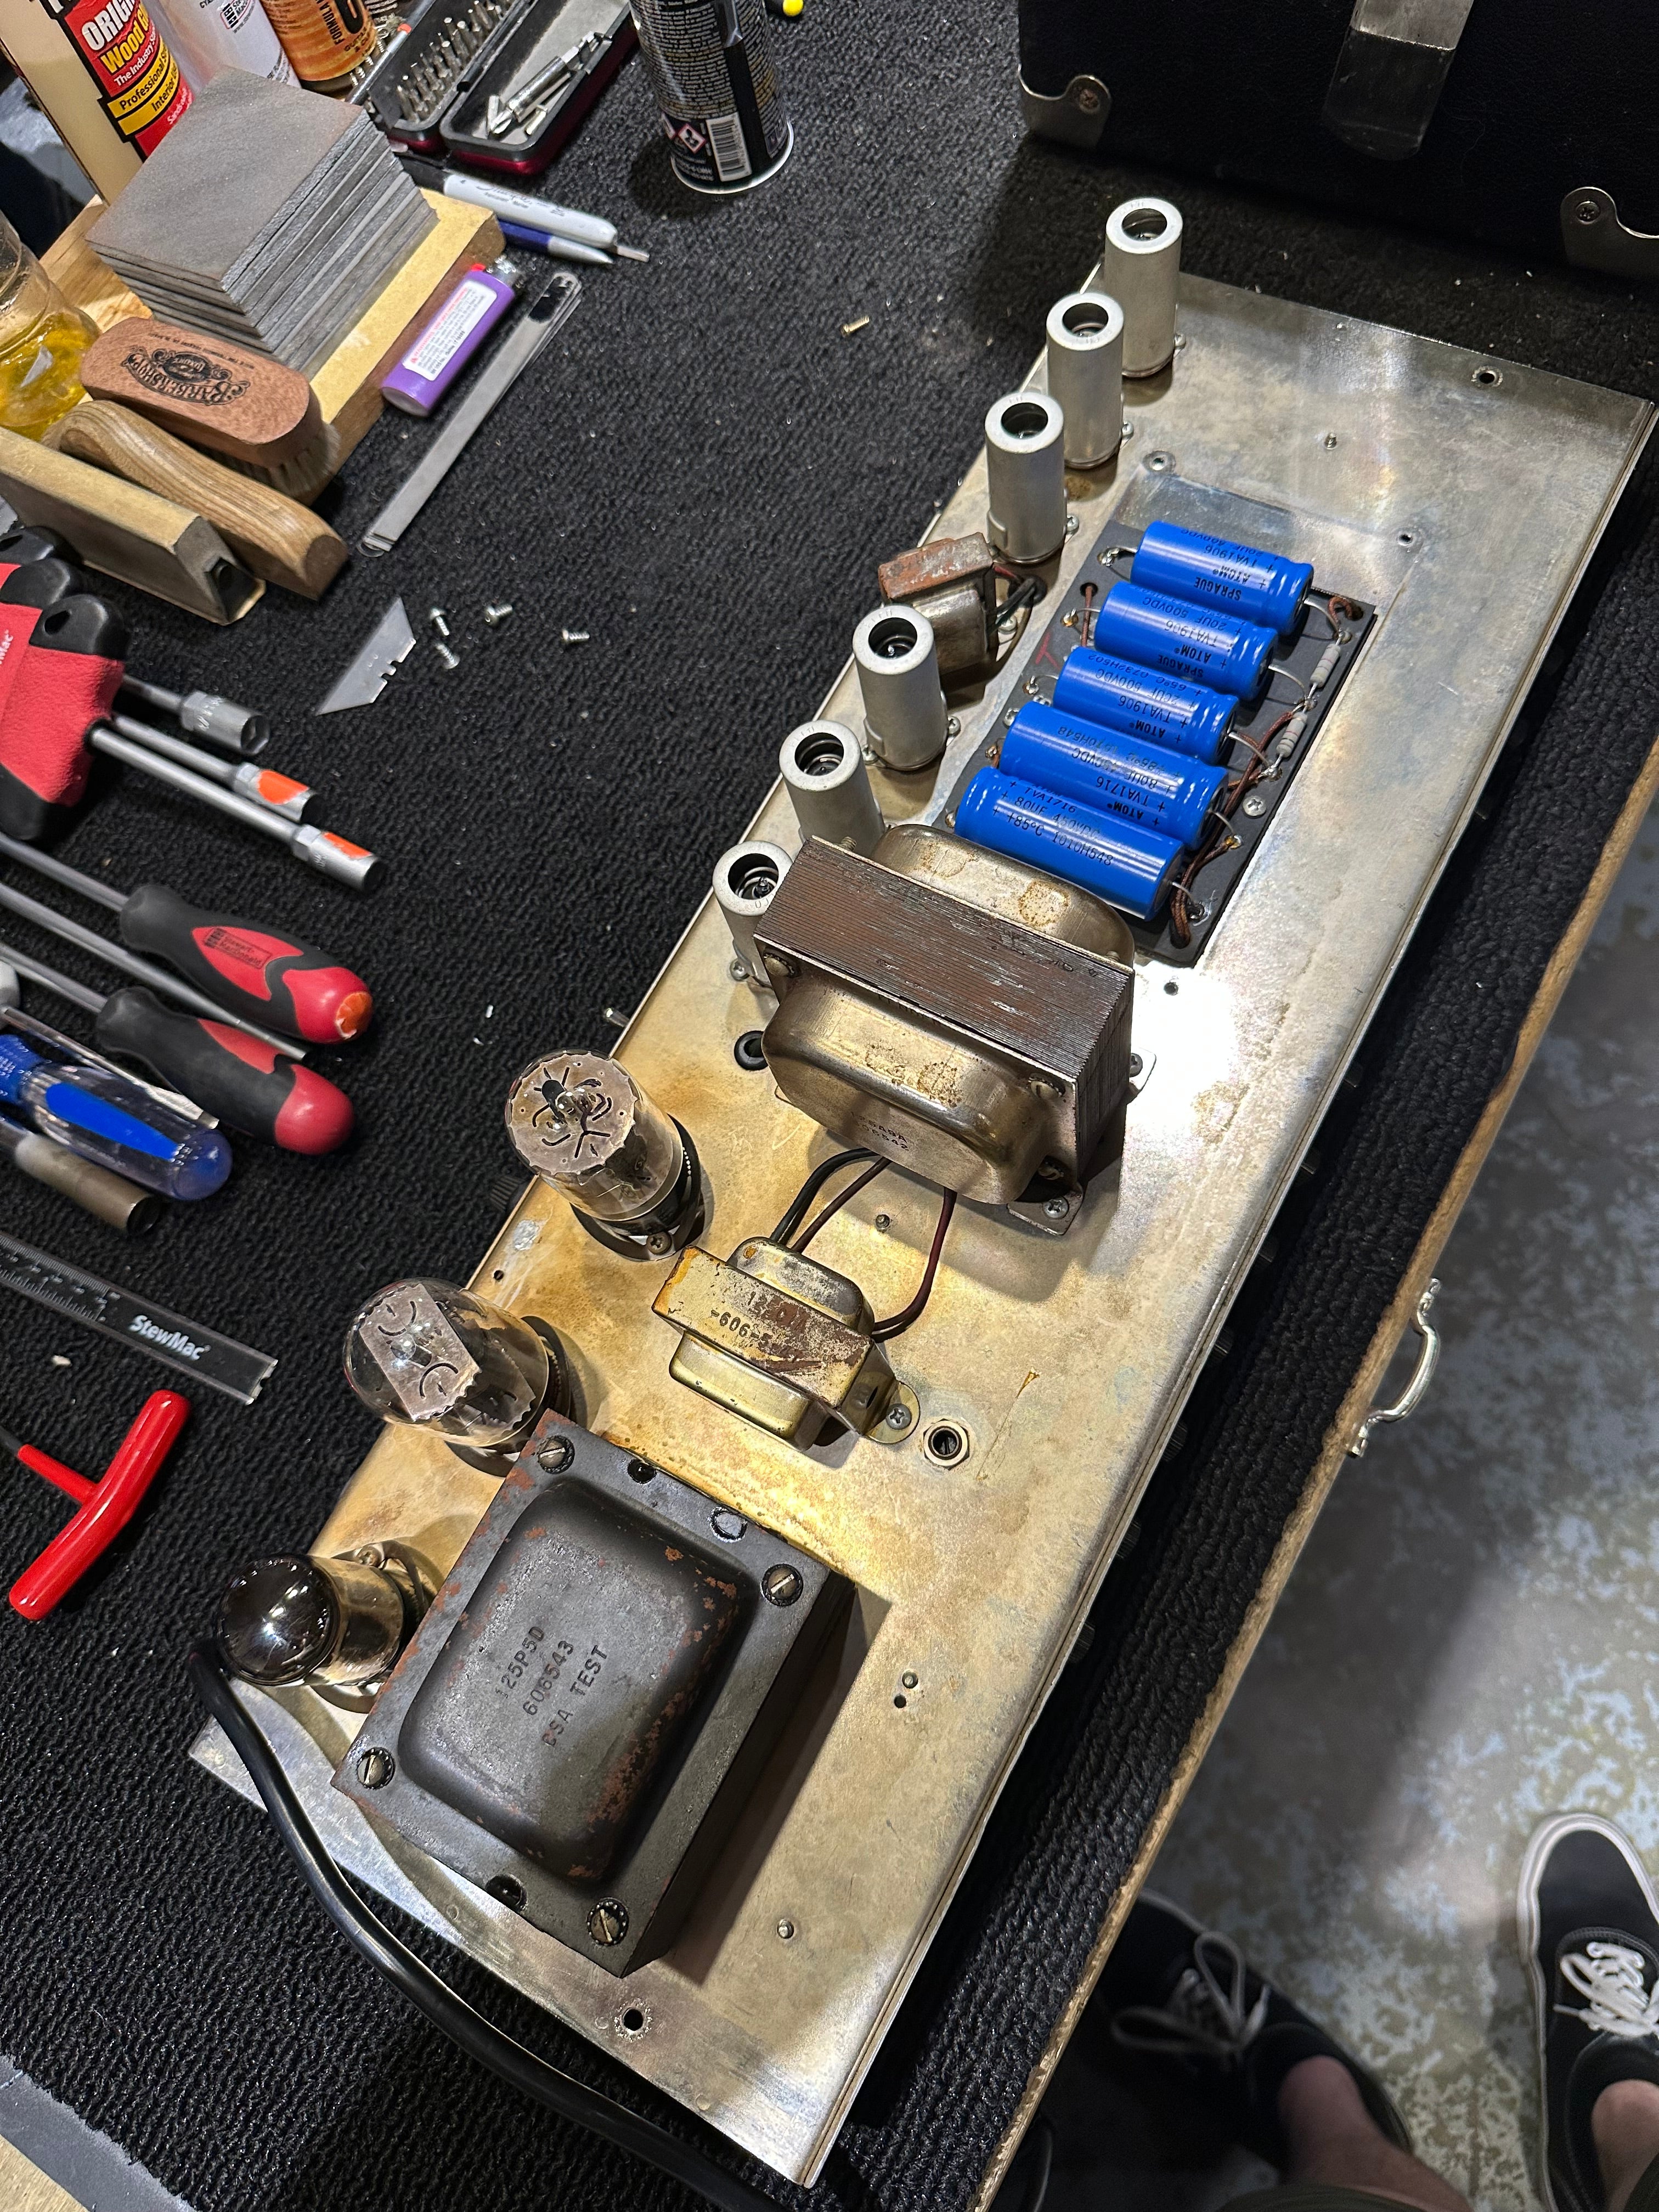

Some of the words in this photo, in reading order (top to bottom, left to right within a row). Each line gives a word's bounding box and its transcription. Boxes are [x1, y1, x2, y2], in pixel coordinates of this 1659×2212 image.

[319, 2, 346, 45] FORMULA
[100, 20, 145, 74] Wood
[114, 71, 133, 87] The
[129, 42, 154, 75] Industry
[119, 57, 166, 111] Professional
[151, 77, 175, 112] Interior
[1203, 544, 1257, 568] TVA1906
[1194, 576, 1243, 601] SPRAGUE
[1142, 597, 1189, 618] 500VDC
[1164, 620, 1218, 648] TVA1906
[1194, 616, 1228, 631] 20UF
[1095, 668, 1143, 692] 500VDC
[1158, 654, 1204, 678] SPRAGUE
[1118, 695, 1171, 724] TVA1906
[1015, 796, 1048, 816] 80UF
[1024, 786, 1078, 814] TVA1716
[1095, 776, 1149, 807] TVA1716
[1052, 832, 1114, 866] 1010H548
[495, 1626, 545, 1699] 125P5D
[569, 1644, 608, 1696] TEST
[523, 1640, 574, 1716] 606543
